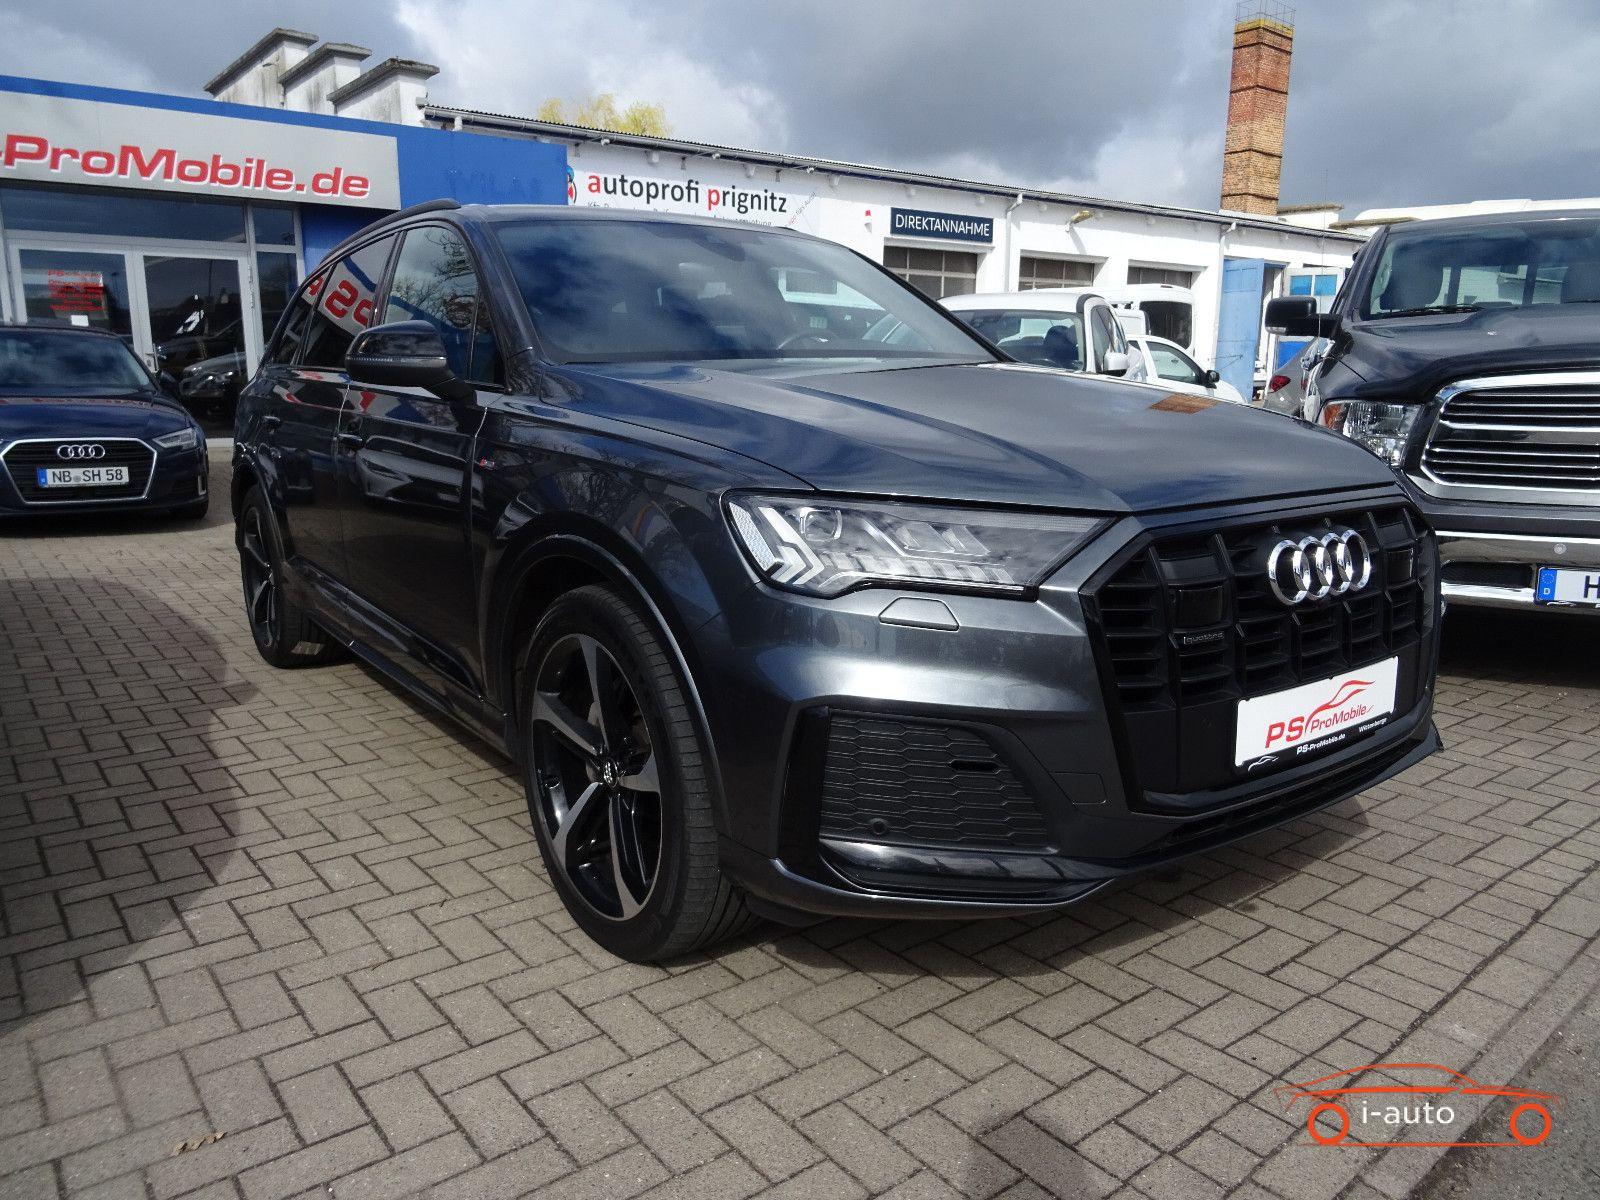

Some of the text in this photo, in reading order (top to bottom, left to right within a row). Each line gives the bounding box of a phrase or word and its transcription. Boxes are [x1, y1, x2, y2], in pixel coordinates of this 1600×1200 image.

[0, 134, 370, 196] ProMobile.de
[588, 174, 699, 204] autoprofi
[708, 185, 787, 214] prignitz
[895, 213, 990, 237] DIREKTANNAHME
[52, 470, 72, 483] NB
[82, 469, 102, 482] SH
[106, 468, 123, 481] 58
[1264, 704, 1367, 749] PS ProMobile
[1296, 733, 1346, 756] PS-ProMobile.de
